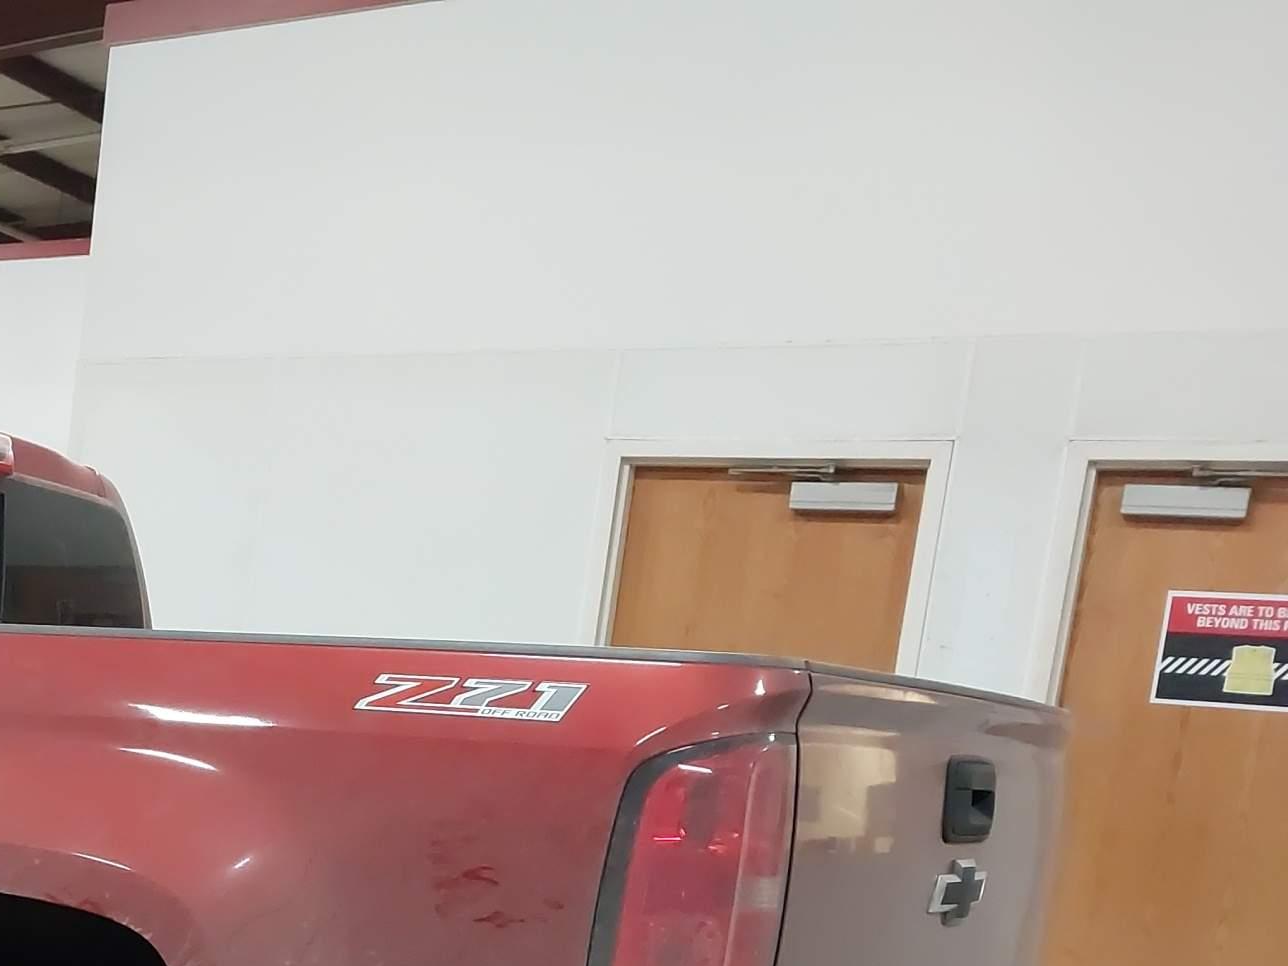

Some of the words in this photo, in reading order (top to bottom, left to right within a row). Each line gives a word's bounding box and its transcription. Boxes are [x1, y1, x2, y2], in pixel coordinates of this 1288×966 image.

[1187, 603, 1226, 615] VESTS
[1228, 605, 1255, 616] ARE
[1257, 606, 1274, 618] TO
[1277, 607, 1288, 619] B
[1197, 617, 1249, 630] BEYOND
[1253, 619, 1281, 631] THIS
[354, 674, 589, 721] Z71
[480, 708, 509, 717] OFF
[515, 710, 561, 720] ROAD
